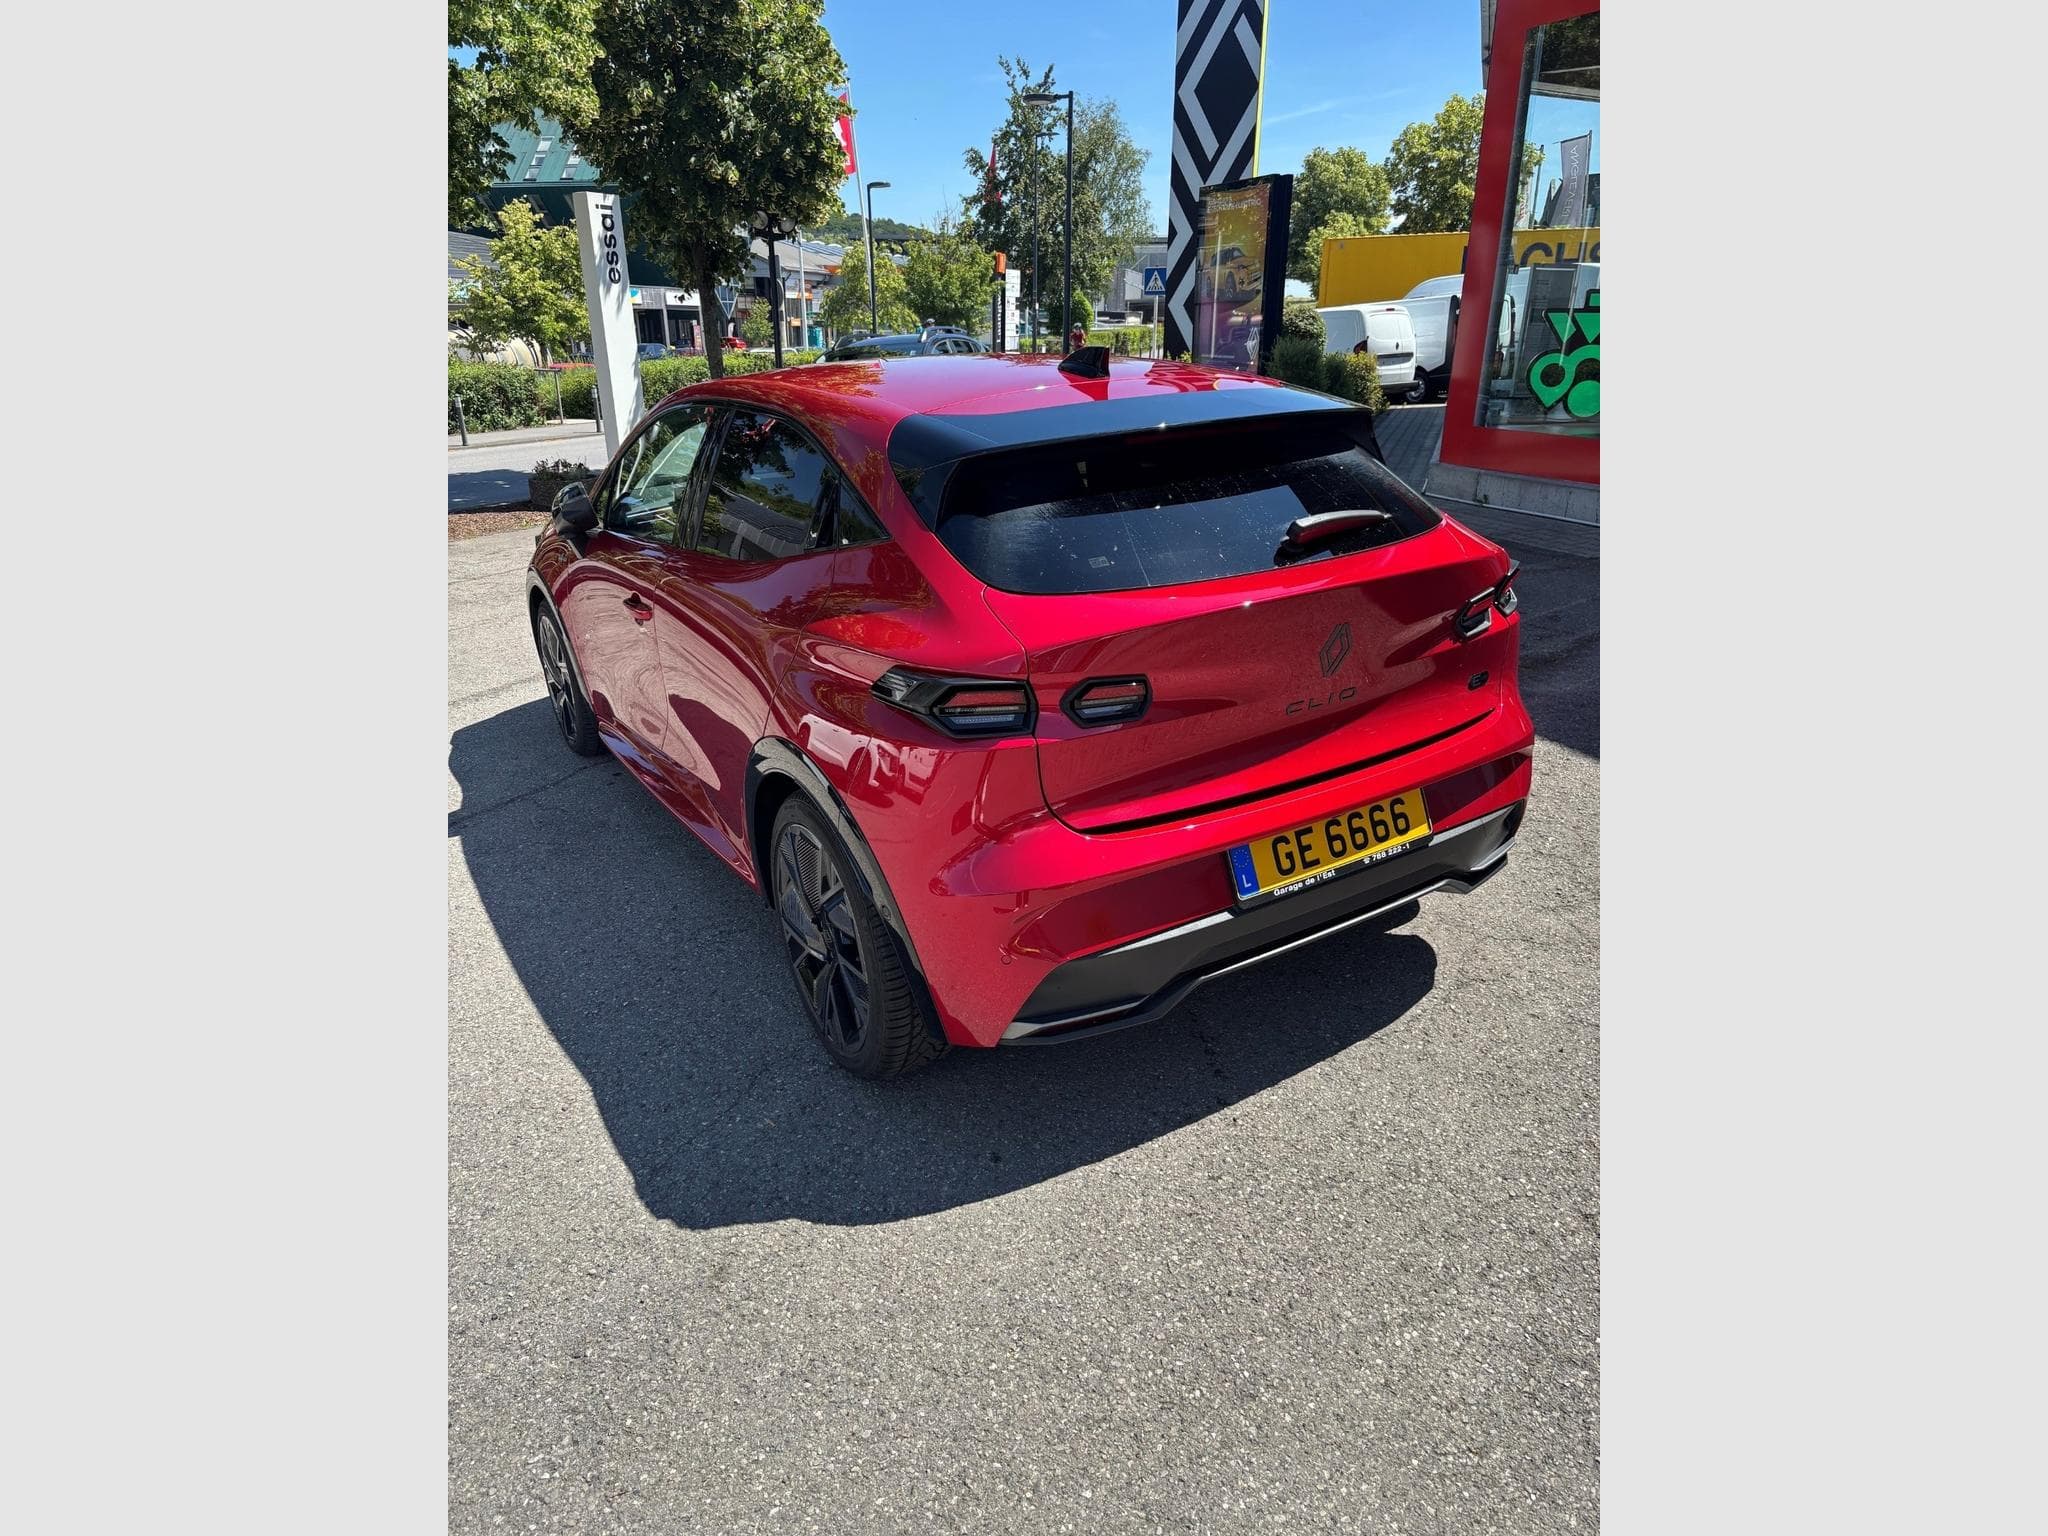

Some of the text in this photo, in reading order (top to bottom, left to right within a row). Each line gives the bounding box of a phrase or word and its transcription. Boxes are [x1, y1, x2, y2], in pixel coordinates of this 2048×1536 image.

[596, 204, 621, 284] essai
[1286, 687, 1356, 715] CLIO
[1271, 797, 1410, 876] GE 6666
[1388, 843, 1410, 856] 222-1
[1242, 874, 1252, 888] L
[1273, 869, 1336, 897] Garage de l'Est
